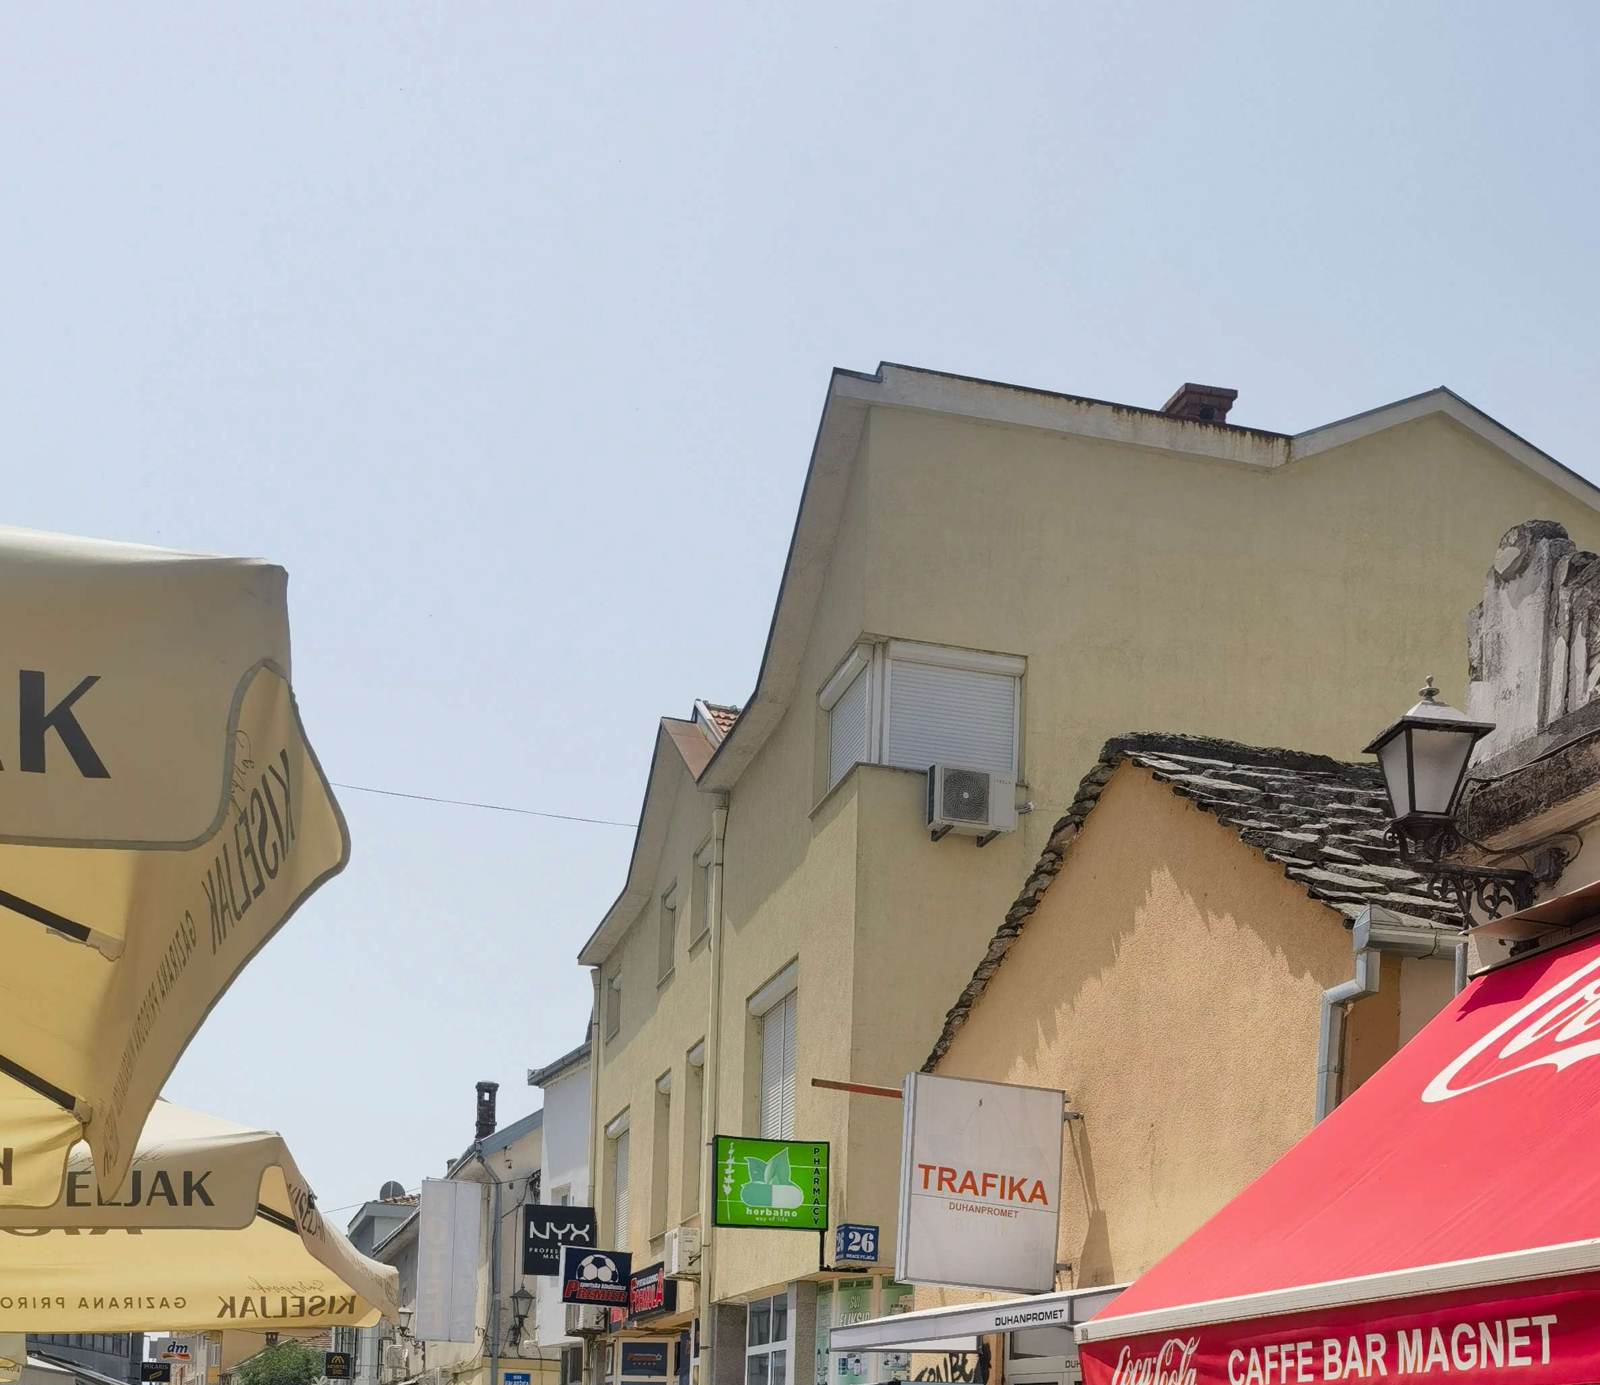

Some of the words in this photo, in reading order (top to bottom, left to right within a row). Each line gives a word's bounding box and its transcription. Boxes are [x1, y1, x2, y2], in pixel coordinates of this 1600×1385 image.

[0, 669, 112, 779] K
[813, 1147, 821, 1225] PHARMACY
[918, 1164, 1048, 1206] TRAFIKA
[949, 1202, 1020, 1219] DUHANPROMET
[529, 1221, 590, 1242] NYX
[848, 1231, 875, 1253] 26
[994, 1309, 1064, 1327] DUHANPROMET
[167, 1341, 188, 1354] dm
[1323, 1333, 1388, 1381] BAR
[1397, 1314, 1558, 1375] MAGNET
